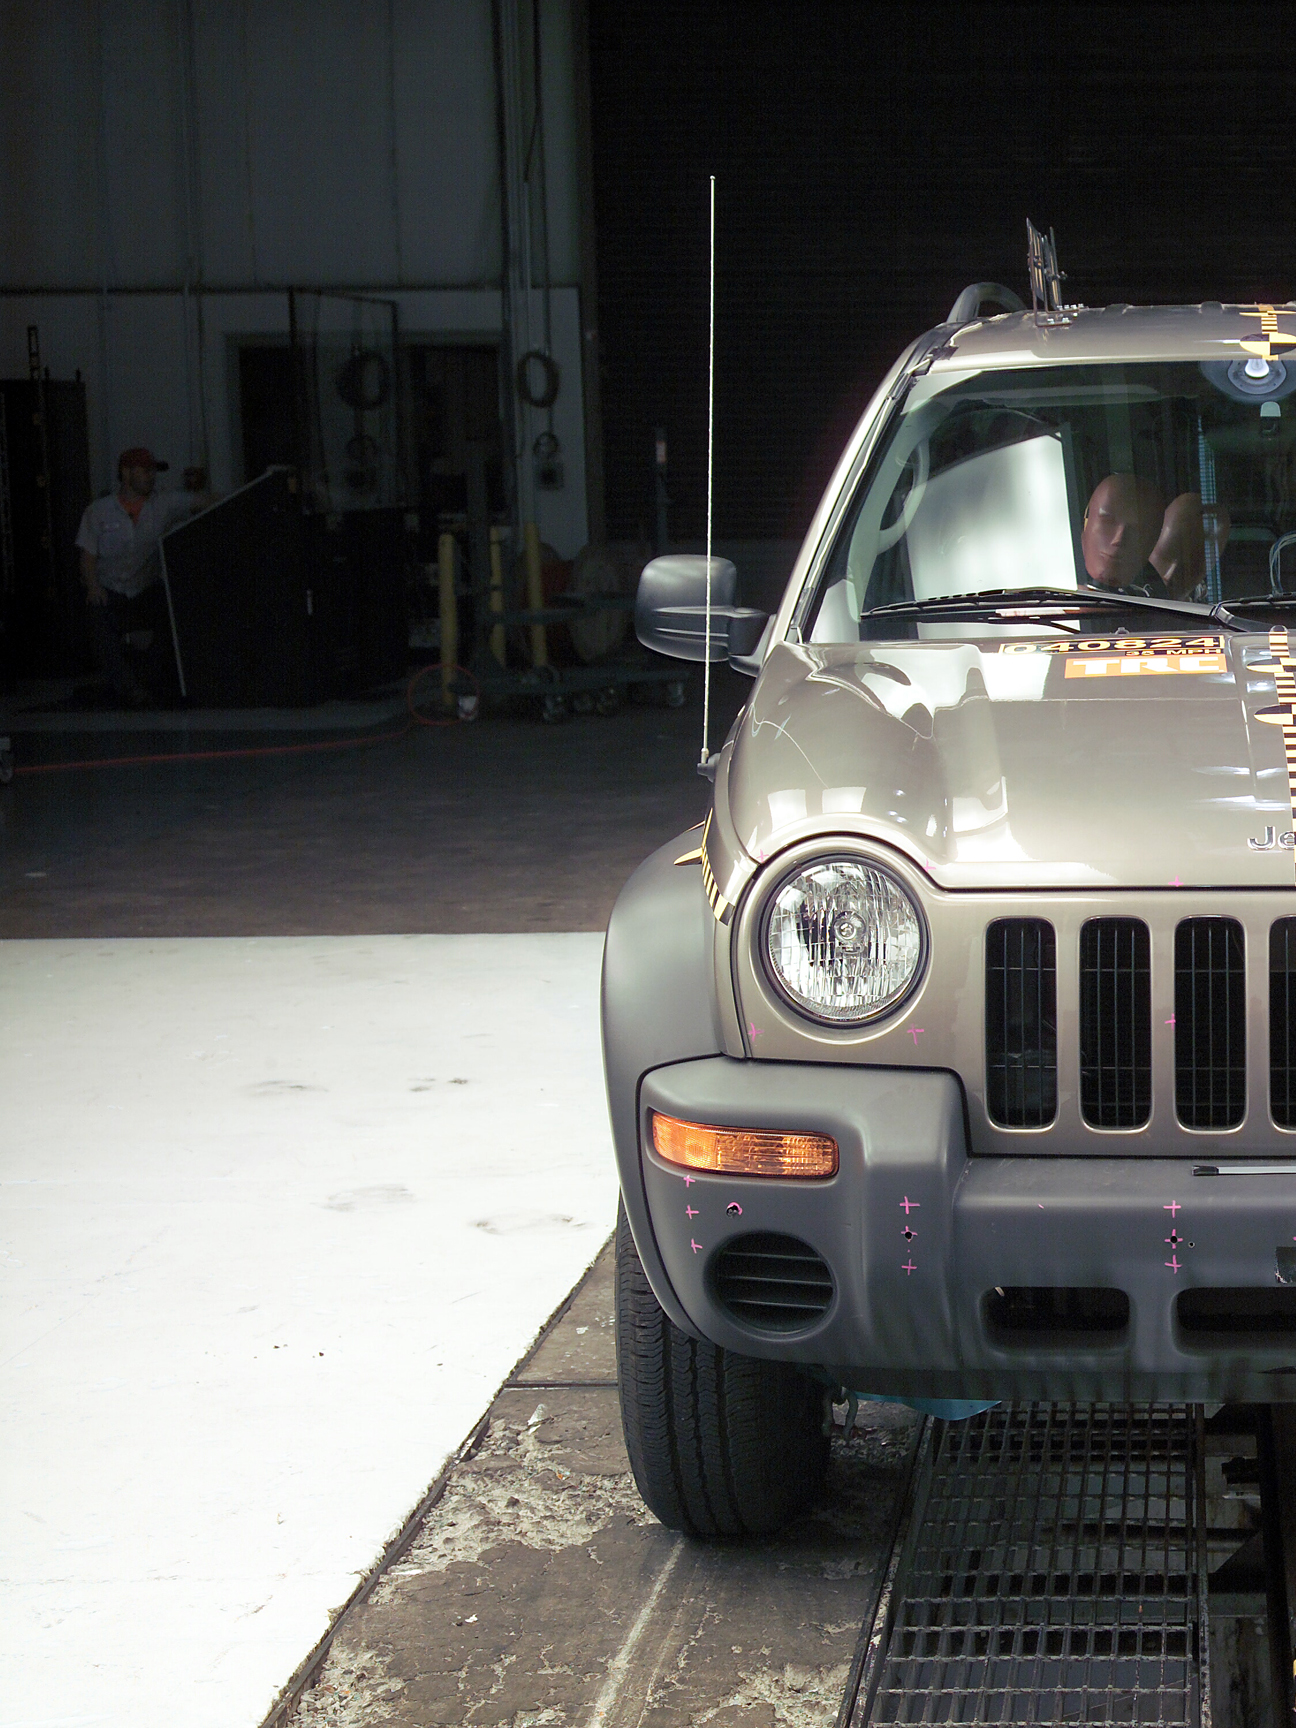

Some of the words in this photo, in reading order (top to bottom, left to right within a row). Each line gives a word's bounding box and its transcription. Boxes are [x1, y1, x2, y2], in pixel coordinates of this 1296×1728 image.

[1004, 637, 1219, 655] 040824
[1166, 648, 1220, 656] MPH
[1073, 656, 1220, 675] TRC
